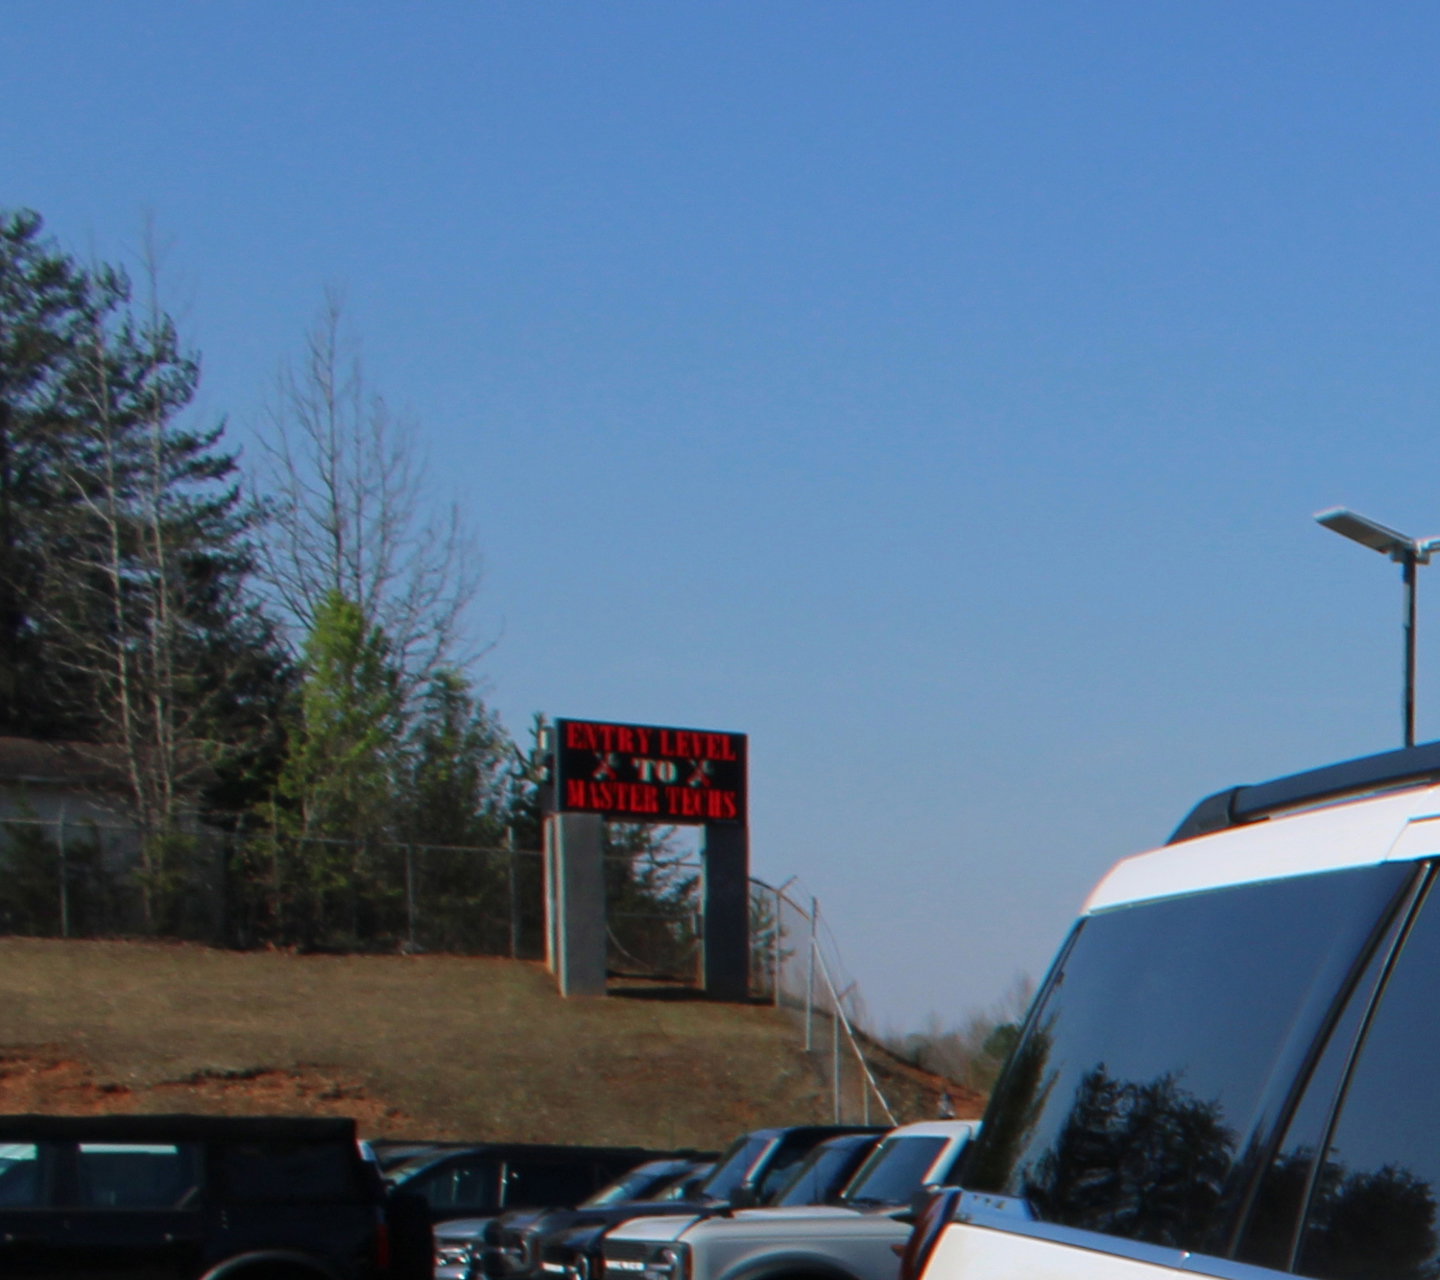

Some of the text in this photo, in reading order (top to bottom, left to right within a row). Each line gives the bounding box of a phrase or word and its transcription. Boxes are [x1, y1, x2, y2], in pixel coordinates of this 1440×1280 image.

[566, 722, 737, 761] ENTRY LEVEL
[631, 758, 678, 784] TO
[565, 779, 737, 819] MASTER TECHS
